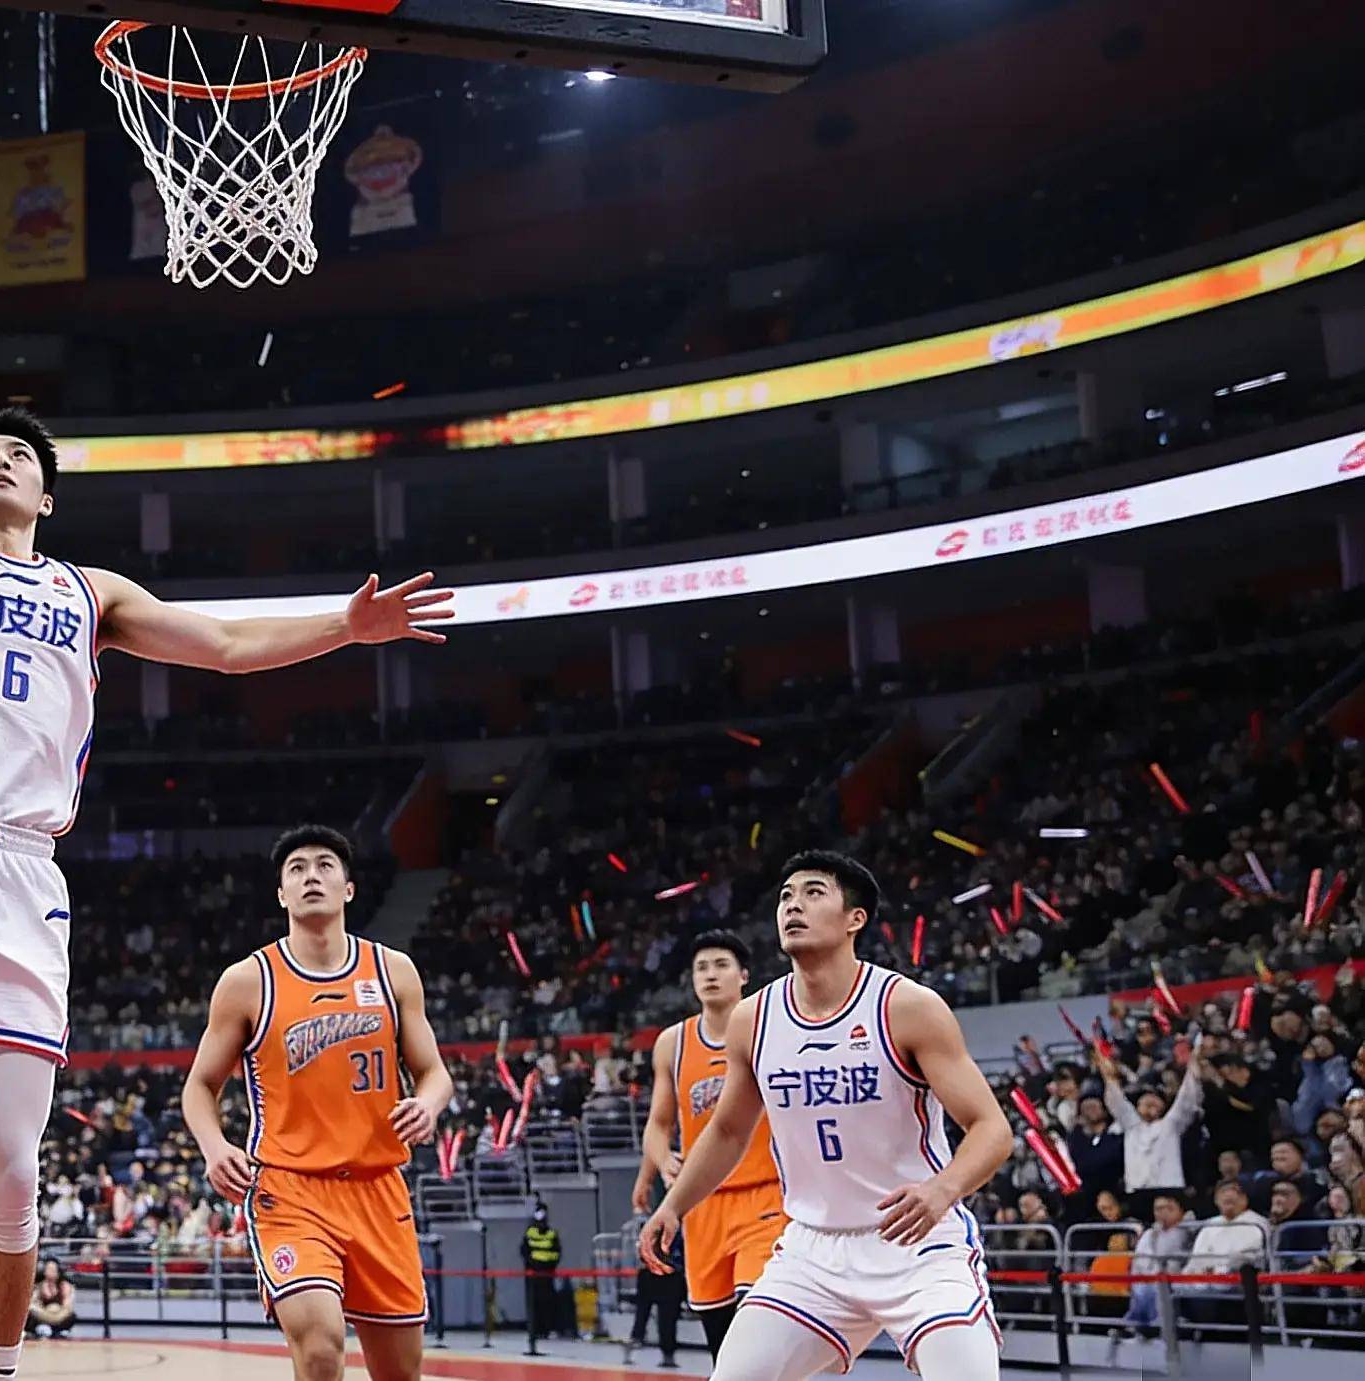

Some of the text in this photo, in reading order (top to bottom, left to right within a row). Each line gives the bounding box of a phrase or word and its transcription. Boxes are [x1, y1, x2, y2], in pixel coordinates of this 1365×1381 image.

[1, 649, 32, 703] 6
[348, 1048, 386, 1093] 31
[767, 1061, 883, 1109] 宁皮波
[816, 1118, 843, 1162] 6
